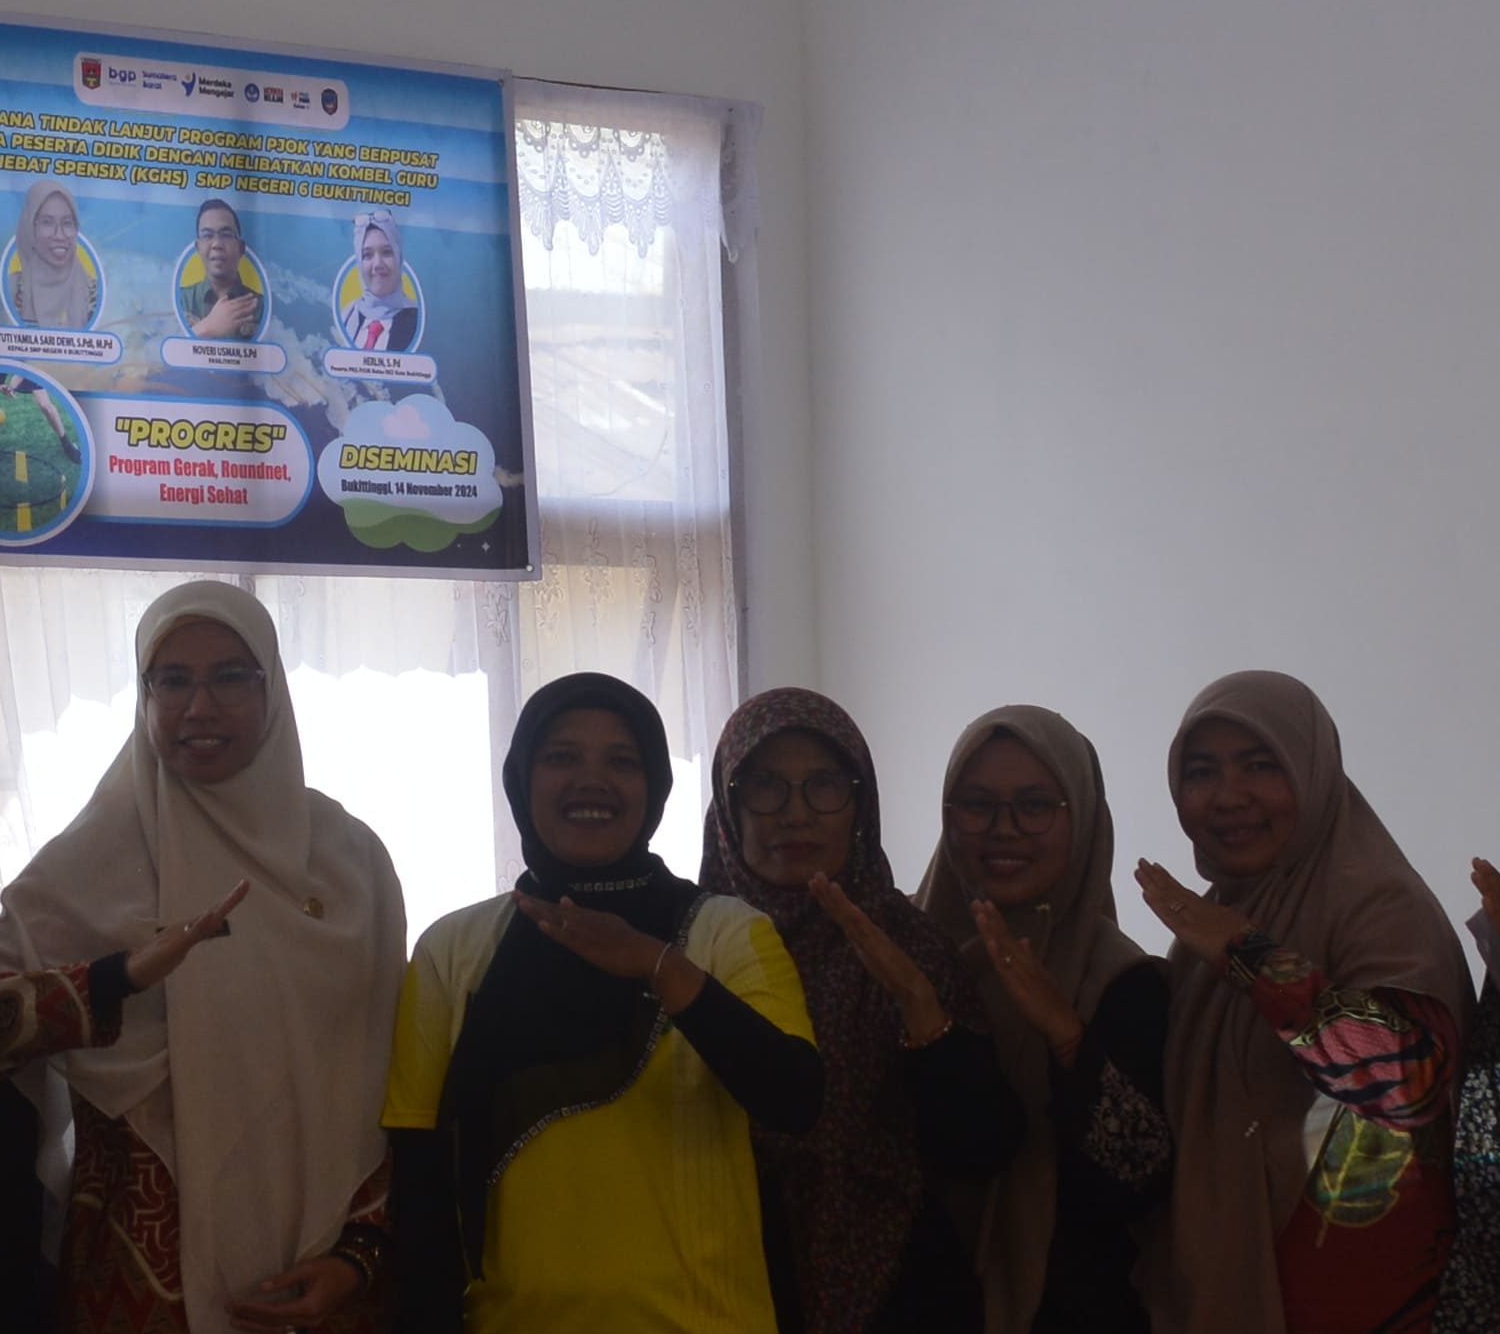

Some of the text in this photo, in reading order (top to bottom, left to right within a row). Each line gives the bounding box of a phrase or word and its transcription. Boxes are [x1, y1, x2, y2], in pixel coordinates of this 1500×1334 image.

[199, 76, 232, 88] Merdeka
[199, 87, 234, 99] Mengajar
[41, 115, 106, 136] TINDAK
[110, 122, 176, 142] LANJUT
[179, 130, 262, 149] PROGRAM
[266, 136, 310, 155] PJOK
[312, 142, 356, 160] YANG
[359, 146, 438, 168] BERPUSAT
[11, 134, 88, 155] PESERTA
[93, 141, 142, 160] DIDIK
[145, 146, 217, 167] DENGAN
[221, 153, 325, 177] MELIBATKAN
[327, 164, 393, 184] KOMBEL
[396, 171, 438, 189] GURU
[54, 160, 127, 180] SPENSIX
[130, 167, 188, 189] (KGHS)
[196, 172, 232, 189] SMP
[236, 176, 295, 195] NEGERI
[299, 182, 309, 197] 6
[311, 183, 411, 206] BUKITTINGGI
[13, 334, 38, 345] YAMILA
[40, 336, 55, 346] SARI
[115, 416, 287, 453] "PROGRES"
[109, 455, 292, 482] Program Gerak, Roundnet,
[339, 444, 478, 475] DISEMINASI
[159, 483, 248, 505] Energi Sehat
[395, 482, 405, 494] 14
[406, 482, 453, 497] November
[455, 484, 478, 498] 2024
